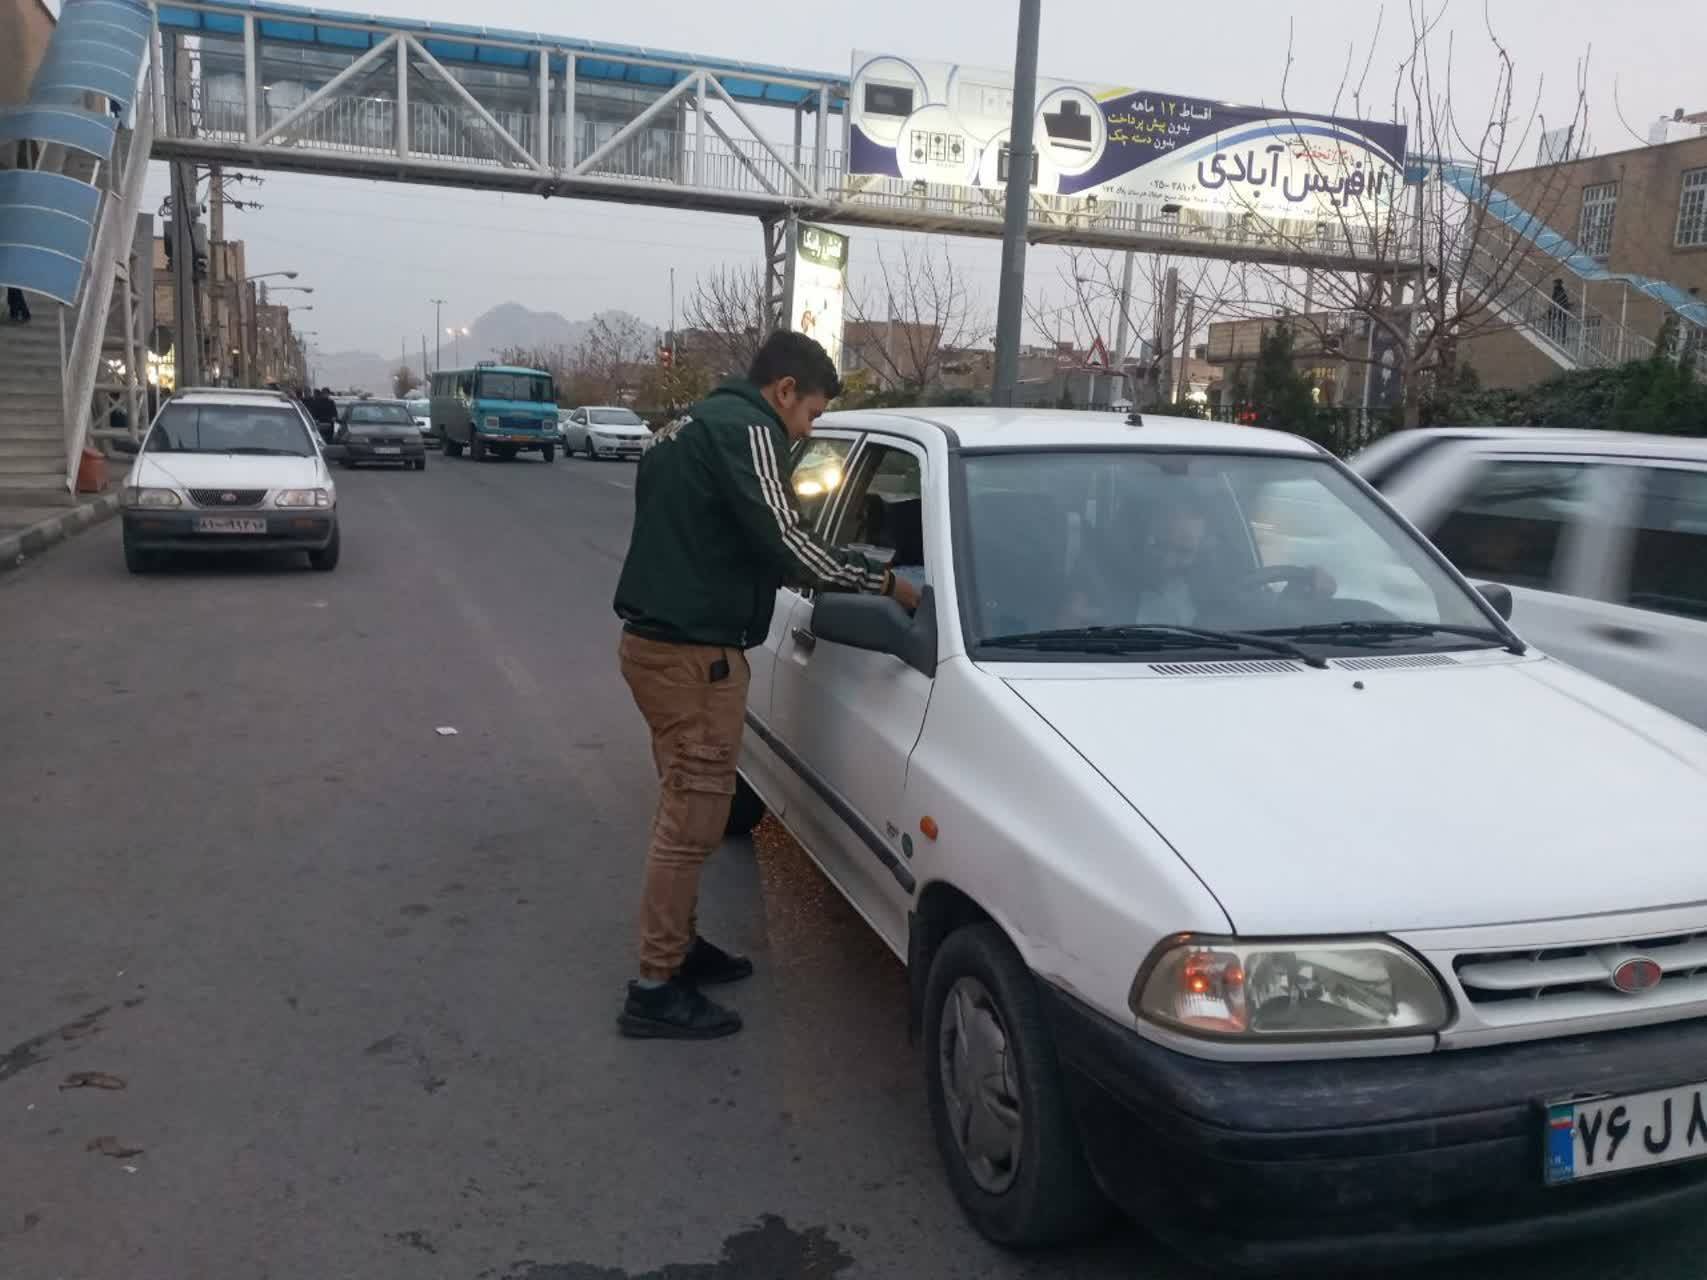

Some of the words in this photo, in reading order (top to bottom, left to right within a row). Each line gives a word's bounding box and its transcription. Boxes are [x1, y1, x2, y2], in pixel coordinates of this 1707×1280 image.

[1131, 98, 1154, 113] ماهه
[1180, 103, 1211, 120] اقساط
[1107, 113, 1144, 131] پرداخت
[1146, 118, 1166, 133] پیش
[1167, 122, 1190, 134] بدون
[1108, 129, 1129, 146] چک
[1131, 133, 1152, 144] دسته
[1153, 137, 1175, 149] بدون
[1198, 145, 1285, 198] آبادی
[1578, 1105, 1631, 1167] ۷۶
[1644, 1098, 1672, 1154] ل
